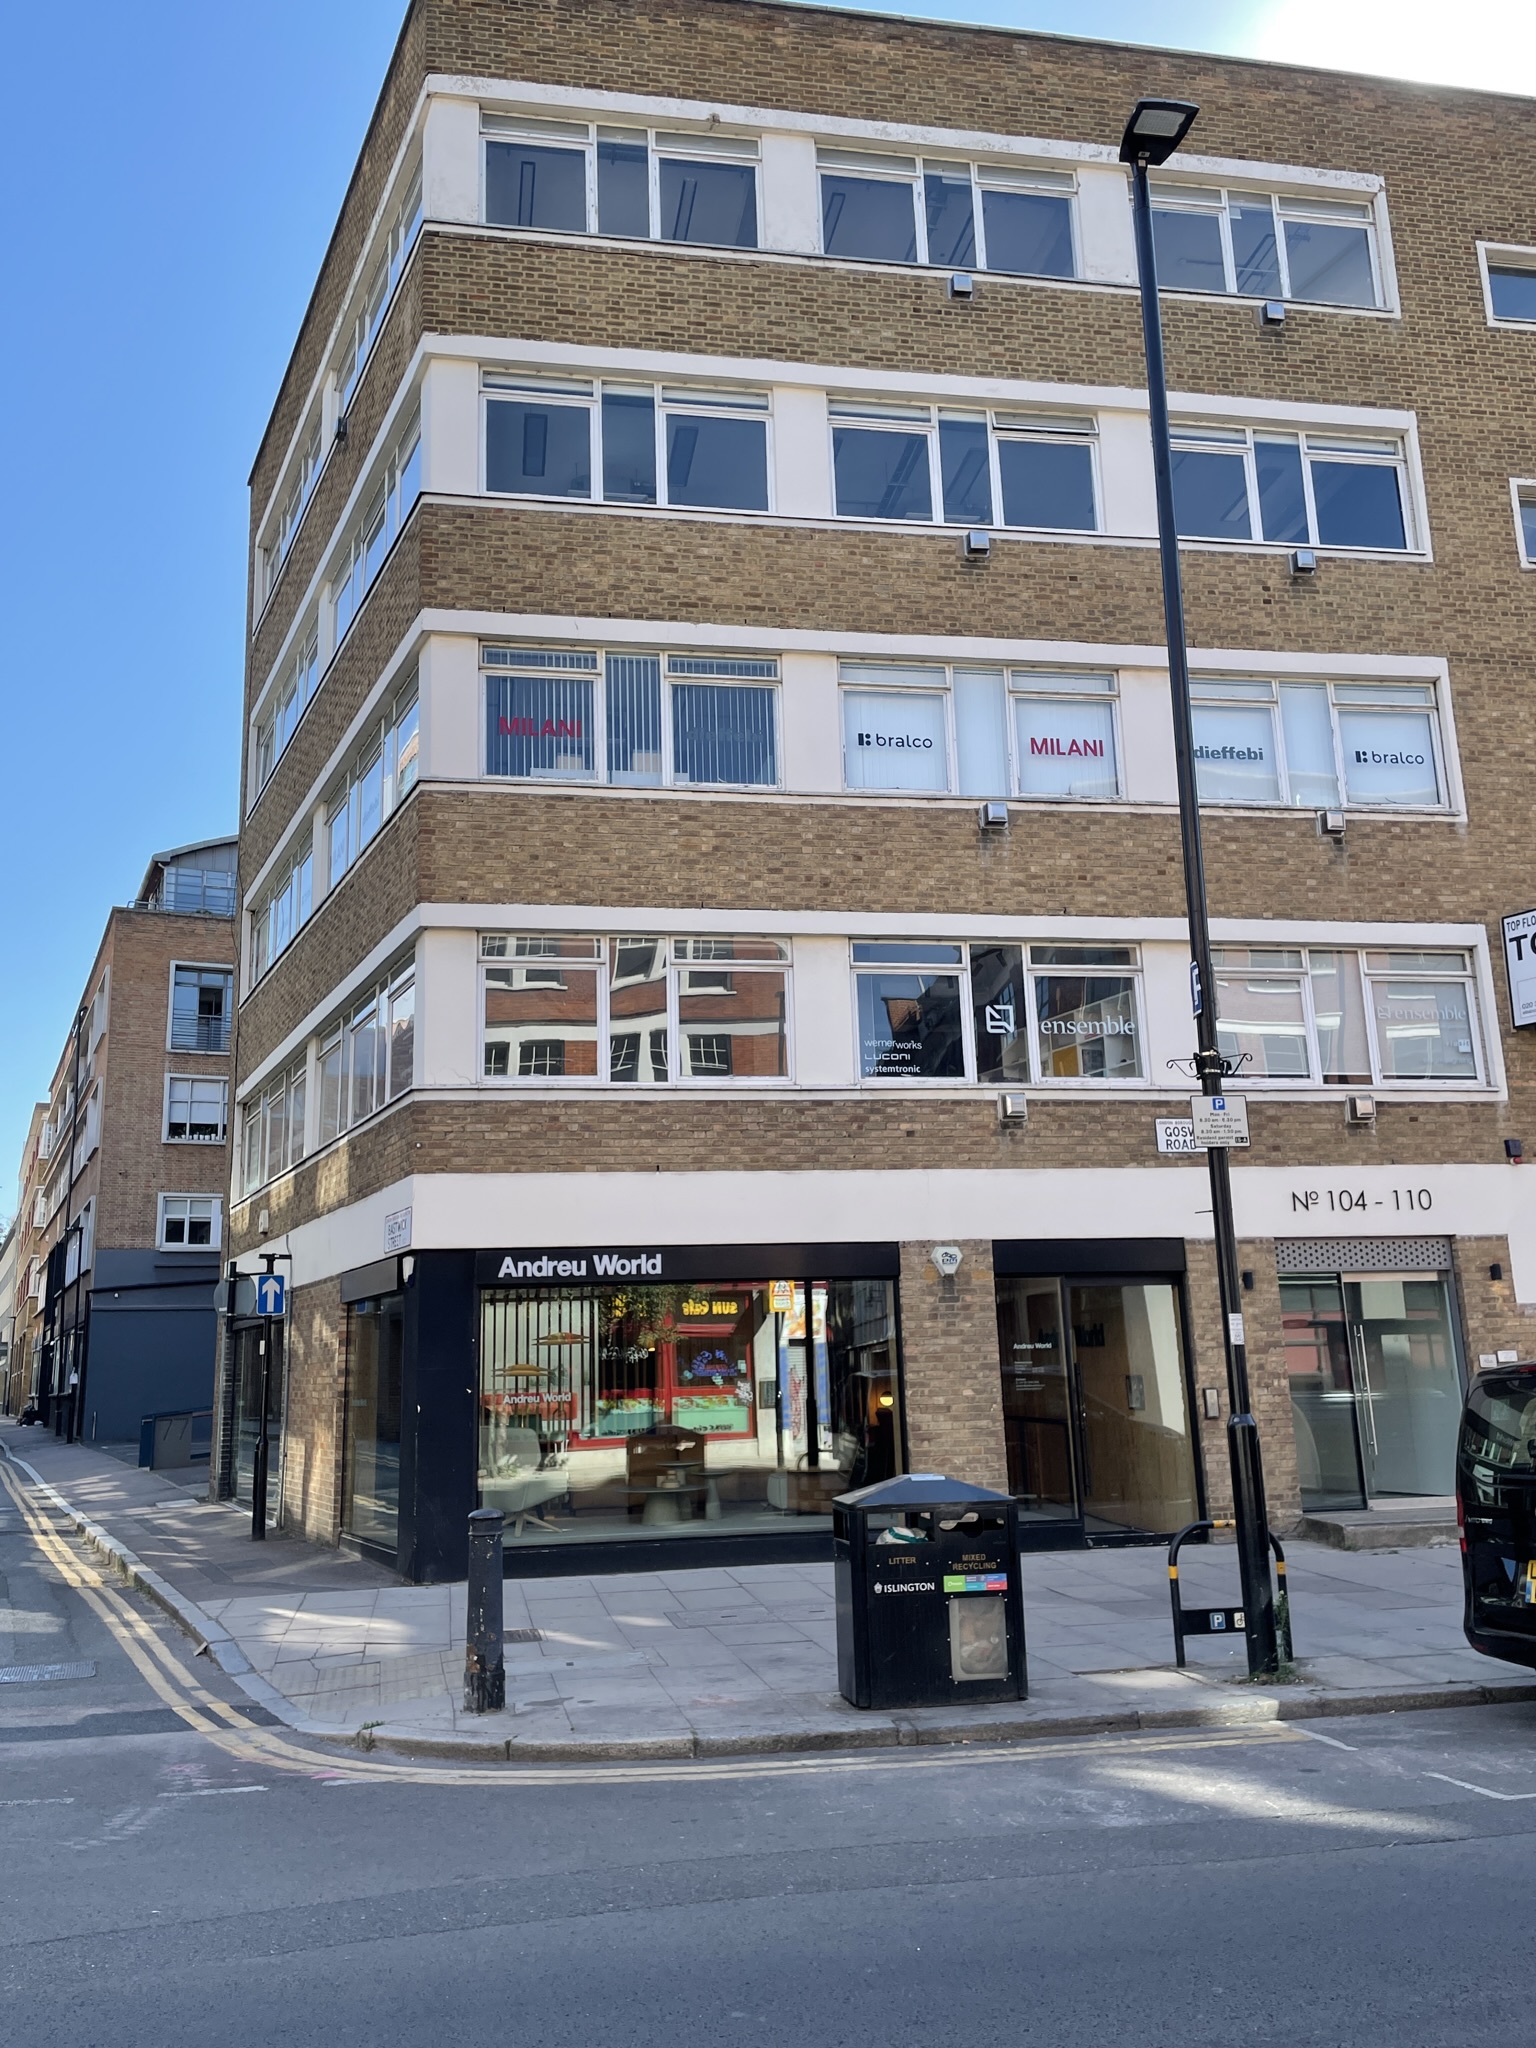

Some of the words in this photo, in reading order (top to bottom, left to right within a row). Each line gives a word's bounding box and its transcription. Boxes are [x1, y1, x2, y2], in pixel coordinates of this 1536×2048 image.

[499, 716, 582, 738] MILANI
[875, 733, 933, 749] bralco
[1030, 737, 1104, 757] MILANI
[1193, 746, 1264, 761] dieffebi
[1371, 750, 1425, 765] bralco
[1506, 919, 1521, 933] TOP
[1394, 1005, 1466, 1020] ensemble
[1040, 1015, 1136, 1036] ensemble
[865, 1064, 921, 1074] systemtronic
[1327, 1190, 1367, 1211] 104
[1393, 1189, 1432, 1210] 110
[498, 1256, 587, 1278] Andreu
[592, 1254, 662, 1275] World
[503, 1394, 540, 1404] Andreu
[543, 1392, 571, 1402] World
[888, 1556, 916, 1565] LITTER
[962, 1554, 986, 1562] MIXED
[952, 1562, 997, 1570] RECYCLING
[884, 1582, 935, 1593] ISLINGTON
[1214, 1615, 1222, 1627] P
